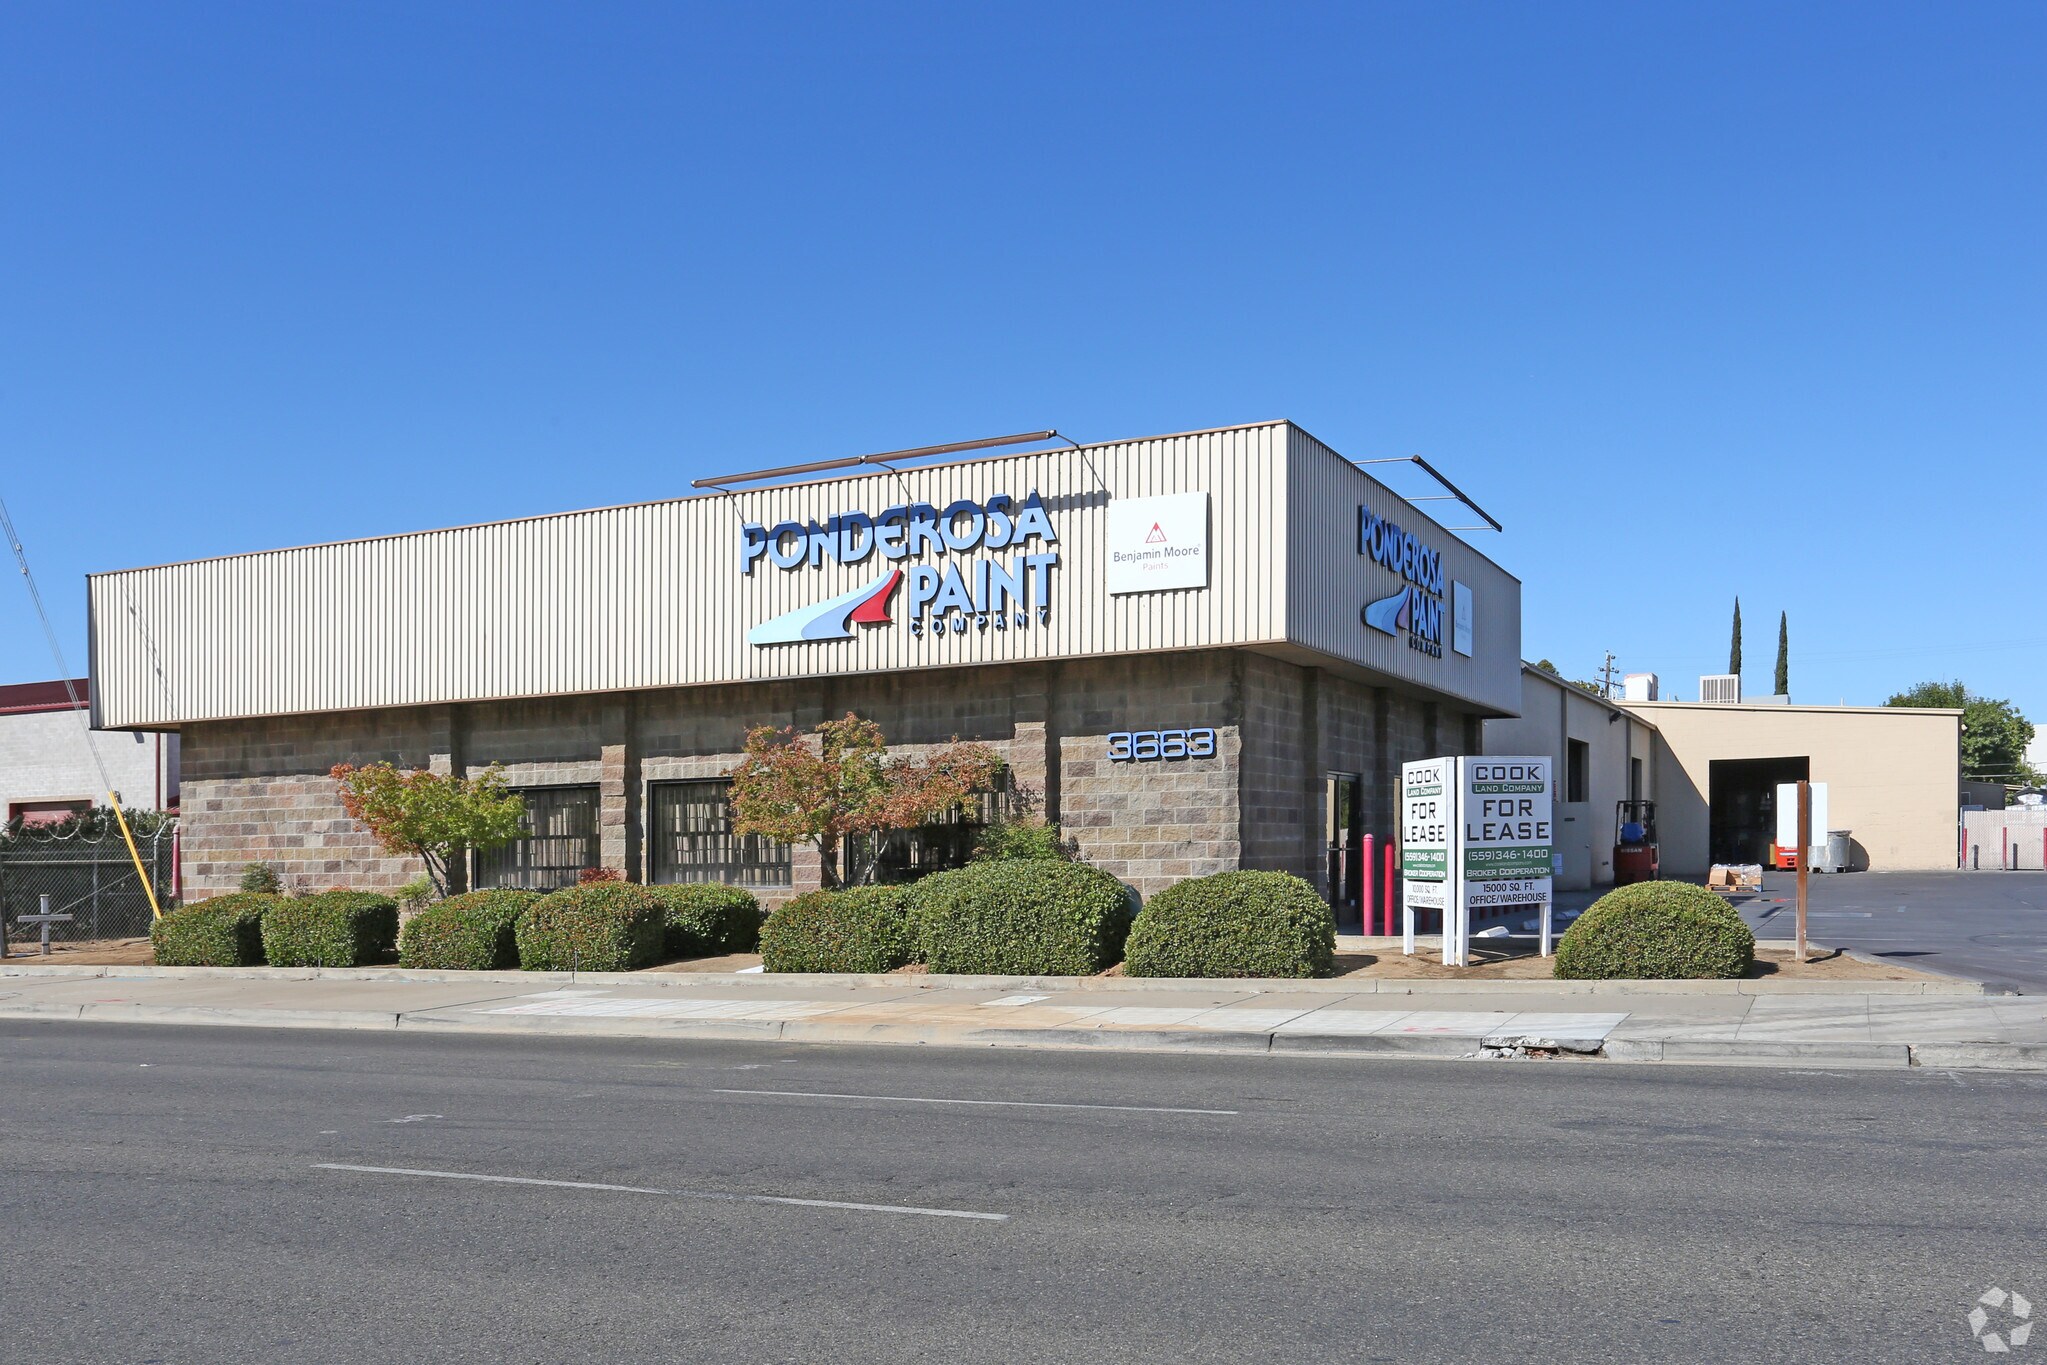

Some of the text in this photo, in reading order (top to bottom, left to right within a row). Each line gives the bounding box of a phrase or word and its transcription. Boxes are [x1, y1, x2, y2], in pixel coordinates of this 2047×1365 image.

[741, 487, 1057, 573] PONDEROSA
[1113, 548, 1161, 563] Benjamin
[1361, 504, 1444, 597] PONDEROSA
[1142, 562, 1169, 571] Paints
[910, 553, 1057, 618] PAINT
[910, 610, 1048, 634] COMPANY
[1412, 588, 1444, 645] PAINT
[1106, 727, 1214, 759] 3663
[1408, 768, 1440, 784] COOK
[1475, 766, 1541, 780] COOK
[1408, 786, 1442, 796] LAND COMPANY
[1475, 783, 1543, 793] LAND COMPANY
[1411, 802, 1436, 819] FOR
[1483, 799, 1533, 817] FOR
[1404, 825, 1445, 842] LEASE
[1467, 822, 1549, 841] LEASE
[1468, 849, 1548, 861] (559)346-1400
[1466, 867, 1550, 877] BROKER COOPERATION
[1483, 882, 1535, 893] 15000 SQ. FT.
[1470, 892, 1547, 904] OFFICE/WAREHOUSE
